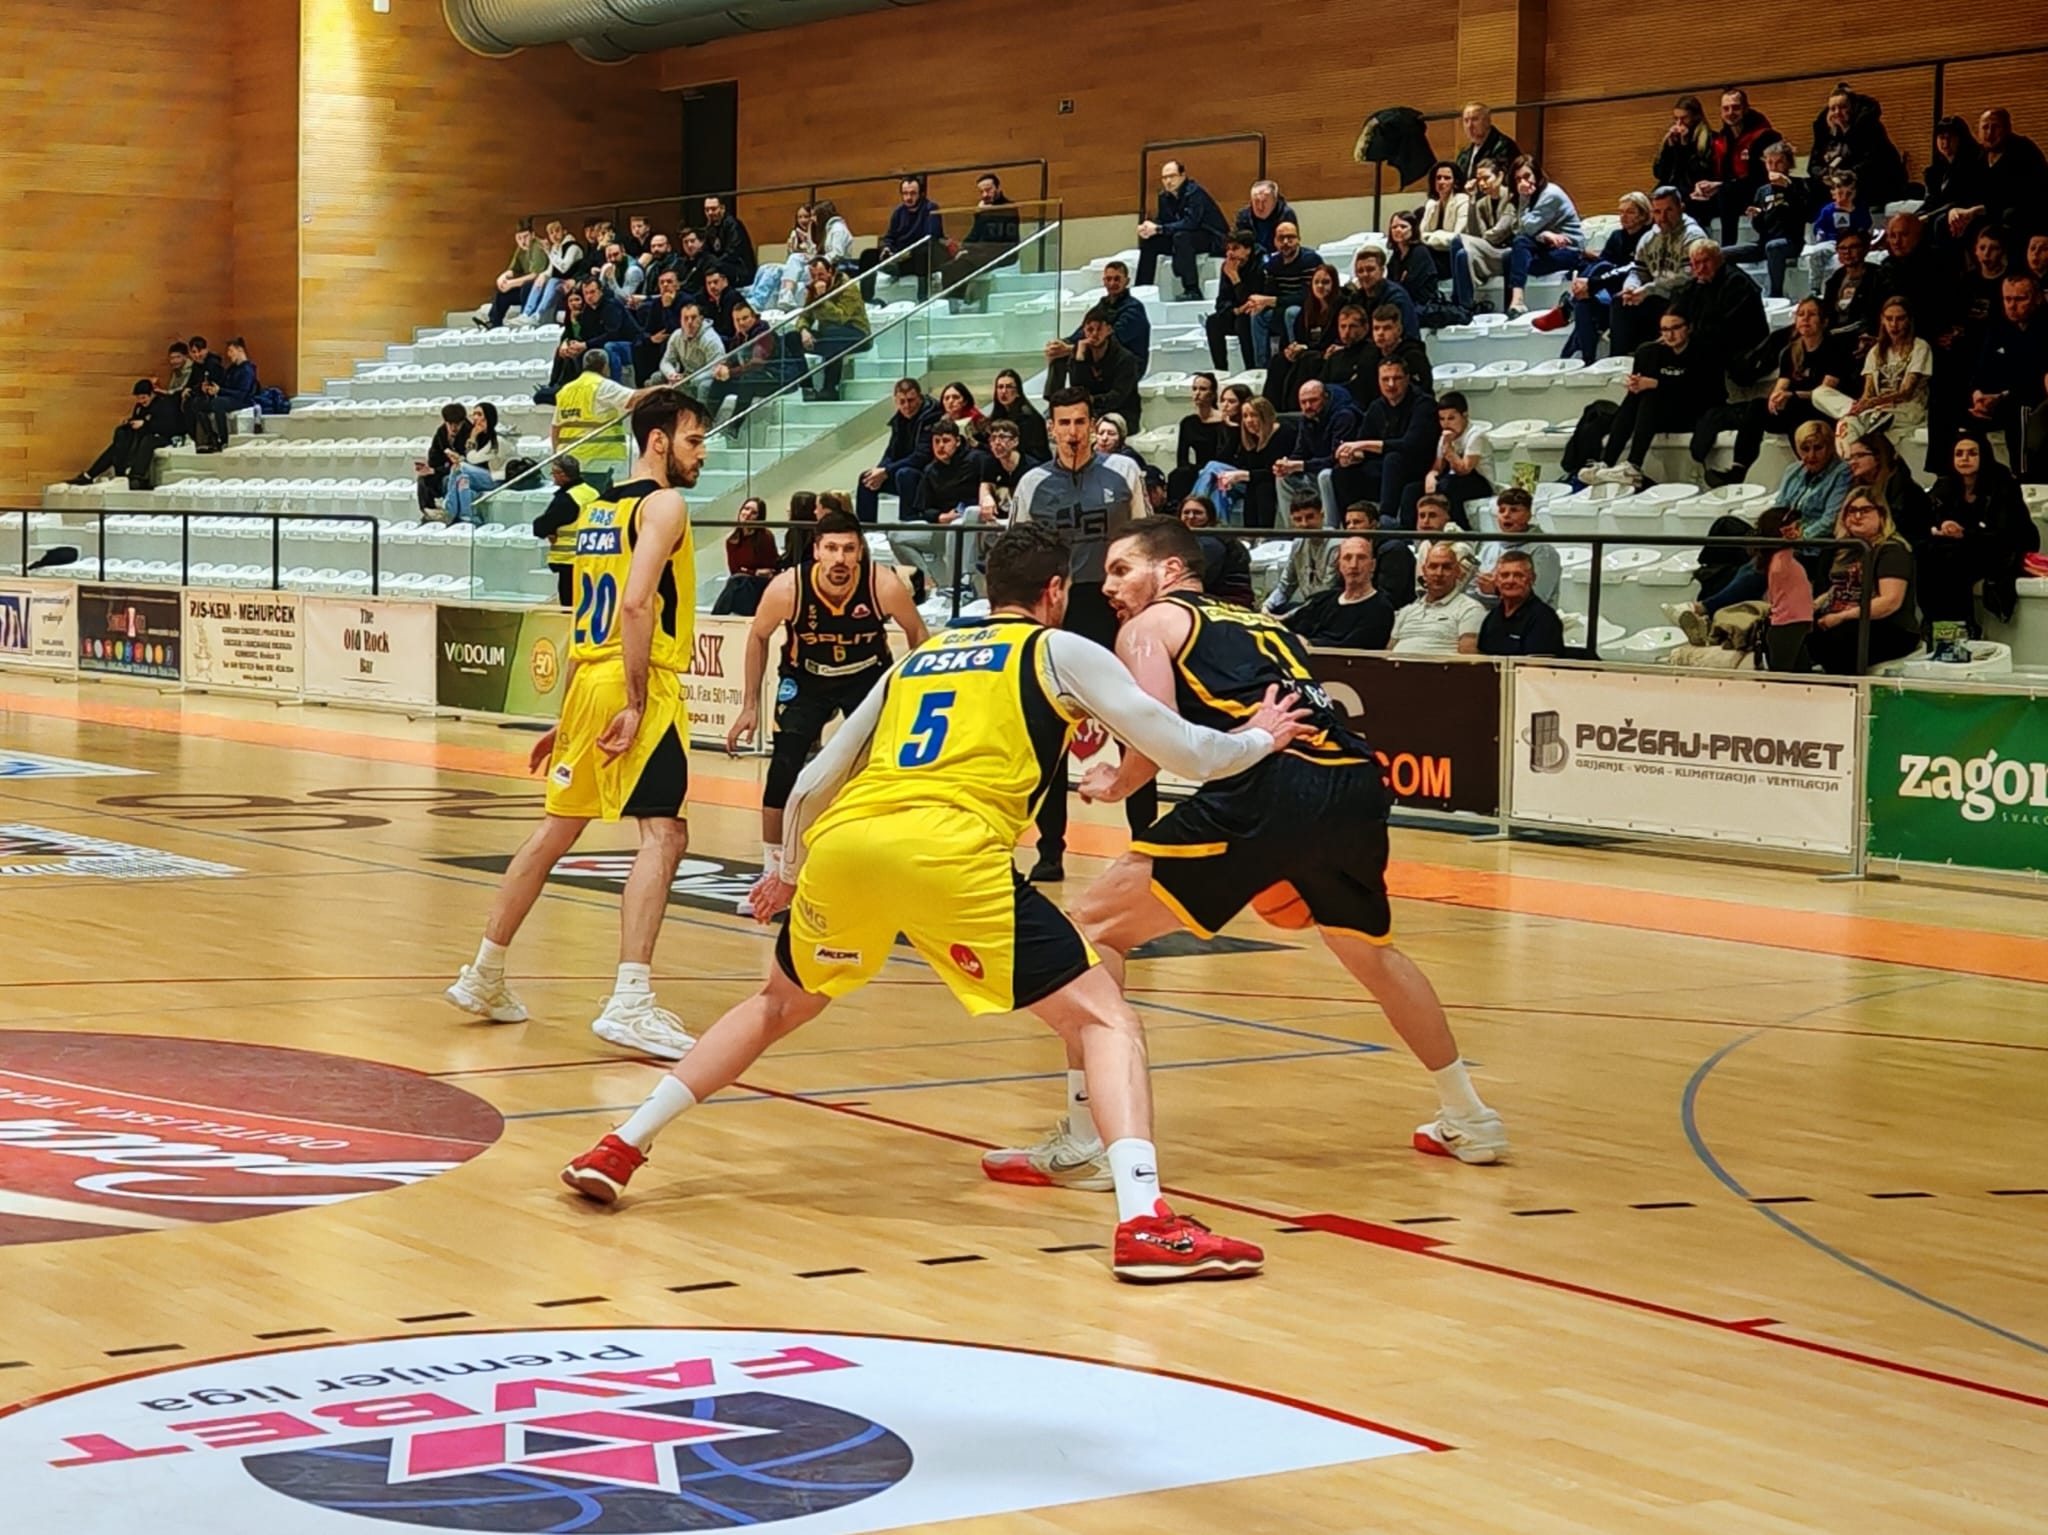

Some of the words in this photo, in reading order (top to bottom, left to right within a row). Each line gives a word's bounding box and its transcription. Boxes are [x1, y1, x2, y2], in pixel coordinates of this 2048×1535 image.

[360, 608, 374, 624] The
[575, 572, 617, 645] 20
[344, 628, 361, 651] Old
[363, 630, 390, 653] Rock
[800, 631, 878, 645] SPLIT
[360, 658, 373, 674] Bar
[913, 649, 978, 673] PSK
[899, 690, 957, 767] 5
[1634, 763, 1665, 776] VODA
[318, 1344, 645, 1393] Premijer
[46, 1345, 863, 1468] FAVBET
[137, 1385, 304, 1412] liga
